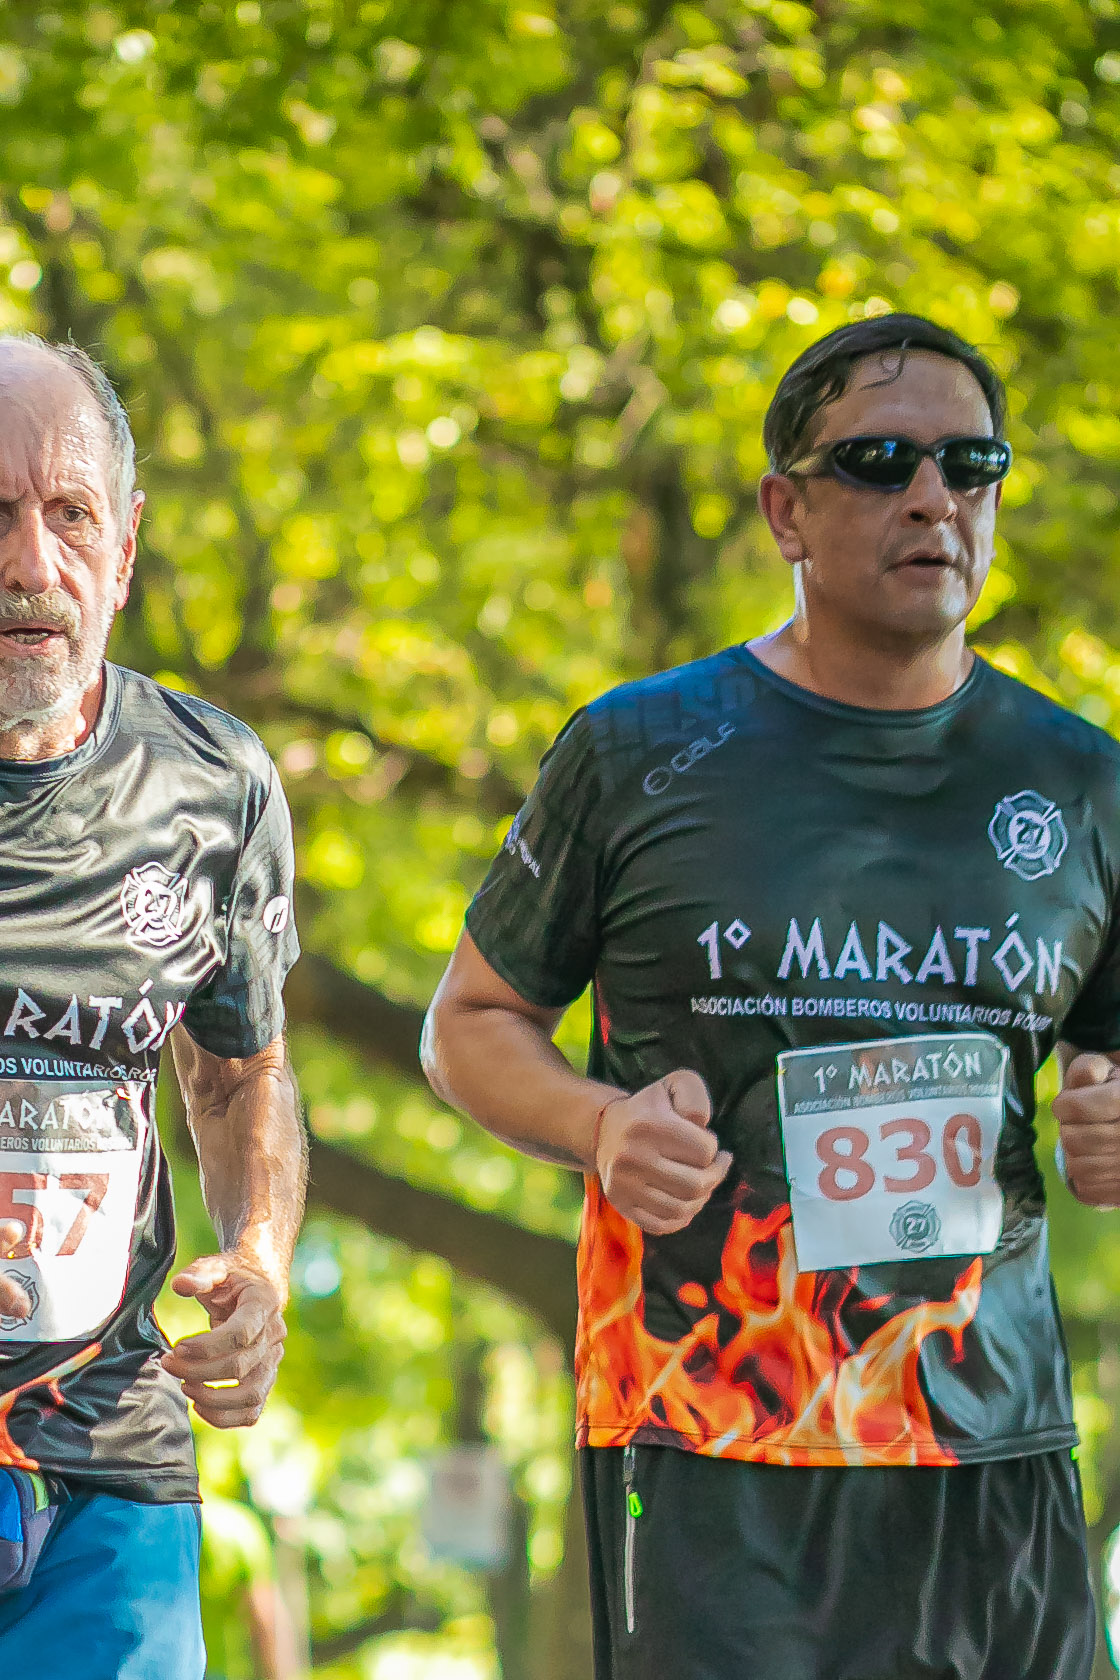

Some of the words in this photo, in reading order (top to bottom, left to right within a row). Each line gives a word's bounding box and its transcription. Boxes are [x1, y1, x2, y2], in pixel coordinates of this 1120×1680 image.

[777, 911, 1063, 996] MARATÓN
[691, 992, 787, 1016] ASOCIACIÓN
[791, 996, 892, 1018] BOMBEROS
[894, 1000, 1013, 1026] VOLUNTARIOS
[21, 1058, 128, 1080] VOLUNTARIOS
[848, 1043, 982, 1090] MARATÓN
[31, 1137, 96, 1153] VOLUNTARIOS
[816, 1113, 982, 1202] 830
[906, 1216, 927, 1235] 27
